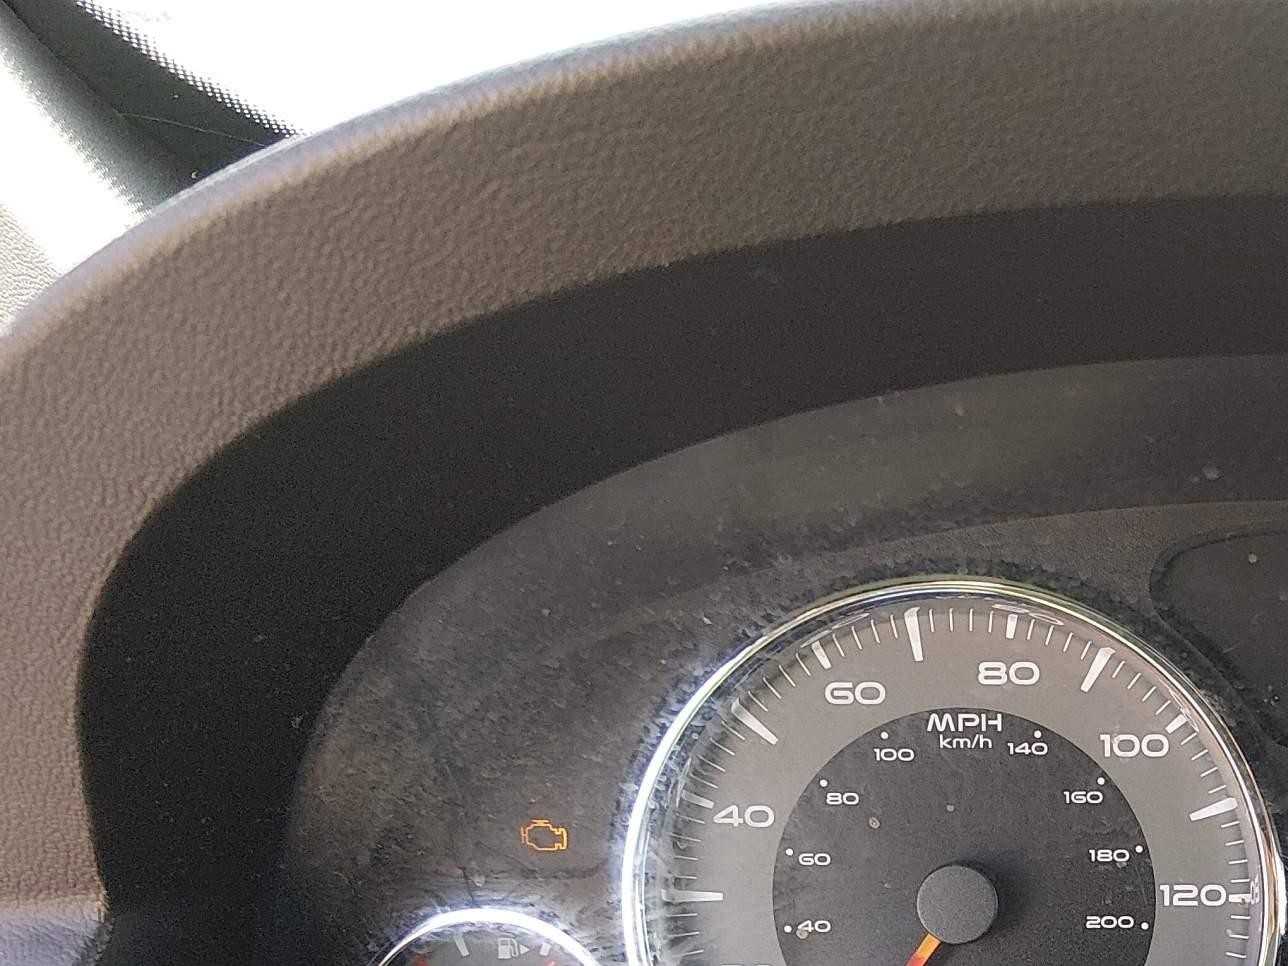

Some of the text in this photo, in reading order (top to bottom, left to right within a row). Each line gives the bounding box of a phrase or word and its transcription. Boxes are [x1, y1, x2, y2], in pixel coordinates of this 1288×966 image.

[978, 662, 1039, 685] 80
[825, 682, 885, 704] 60
[927, 713, 1001, 731] MPH
[940, 734, 992, 748] km/h
[1100, 734, 1169, 757] 100
[874, 749, 914, 761] 100
[1008, 743, 1047, 755] 140
[827, 793, 859, 804] 80
[1064, 791, 1103, 803] 160
[714, 805, 774, 827] 40
[799, 853, 830, 865] 60
[1089, 850, 1129, 861] 180
[1160, 885, 1226, 906] 120
[799, 920, 831, 933] 40
[1086, 916, 1134, 928] 200
